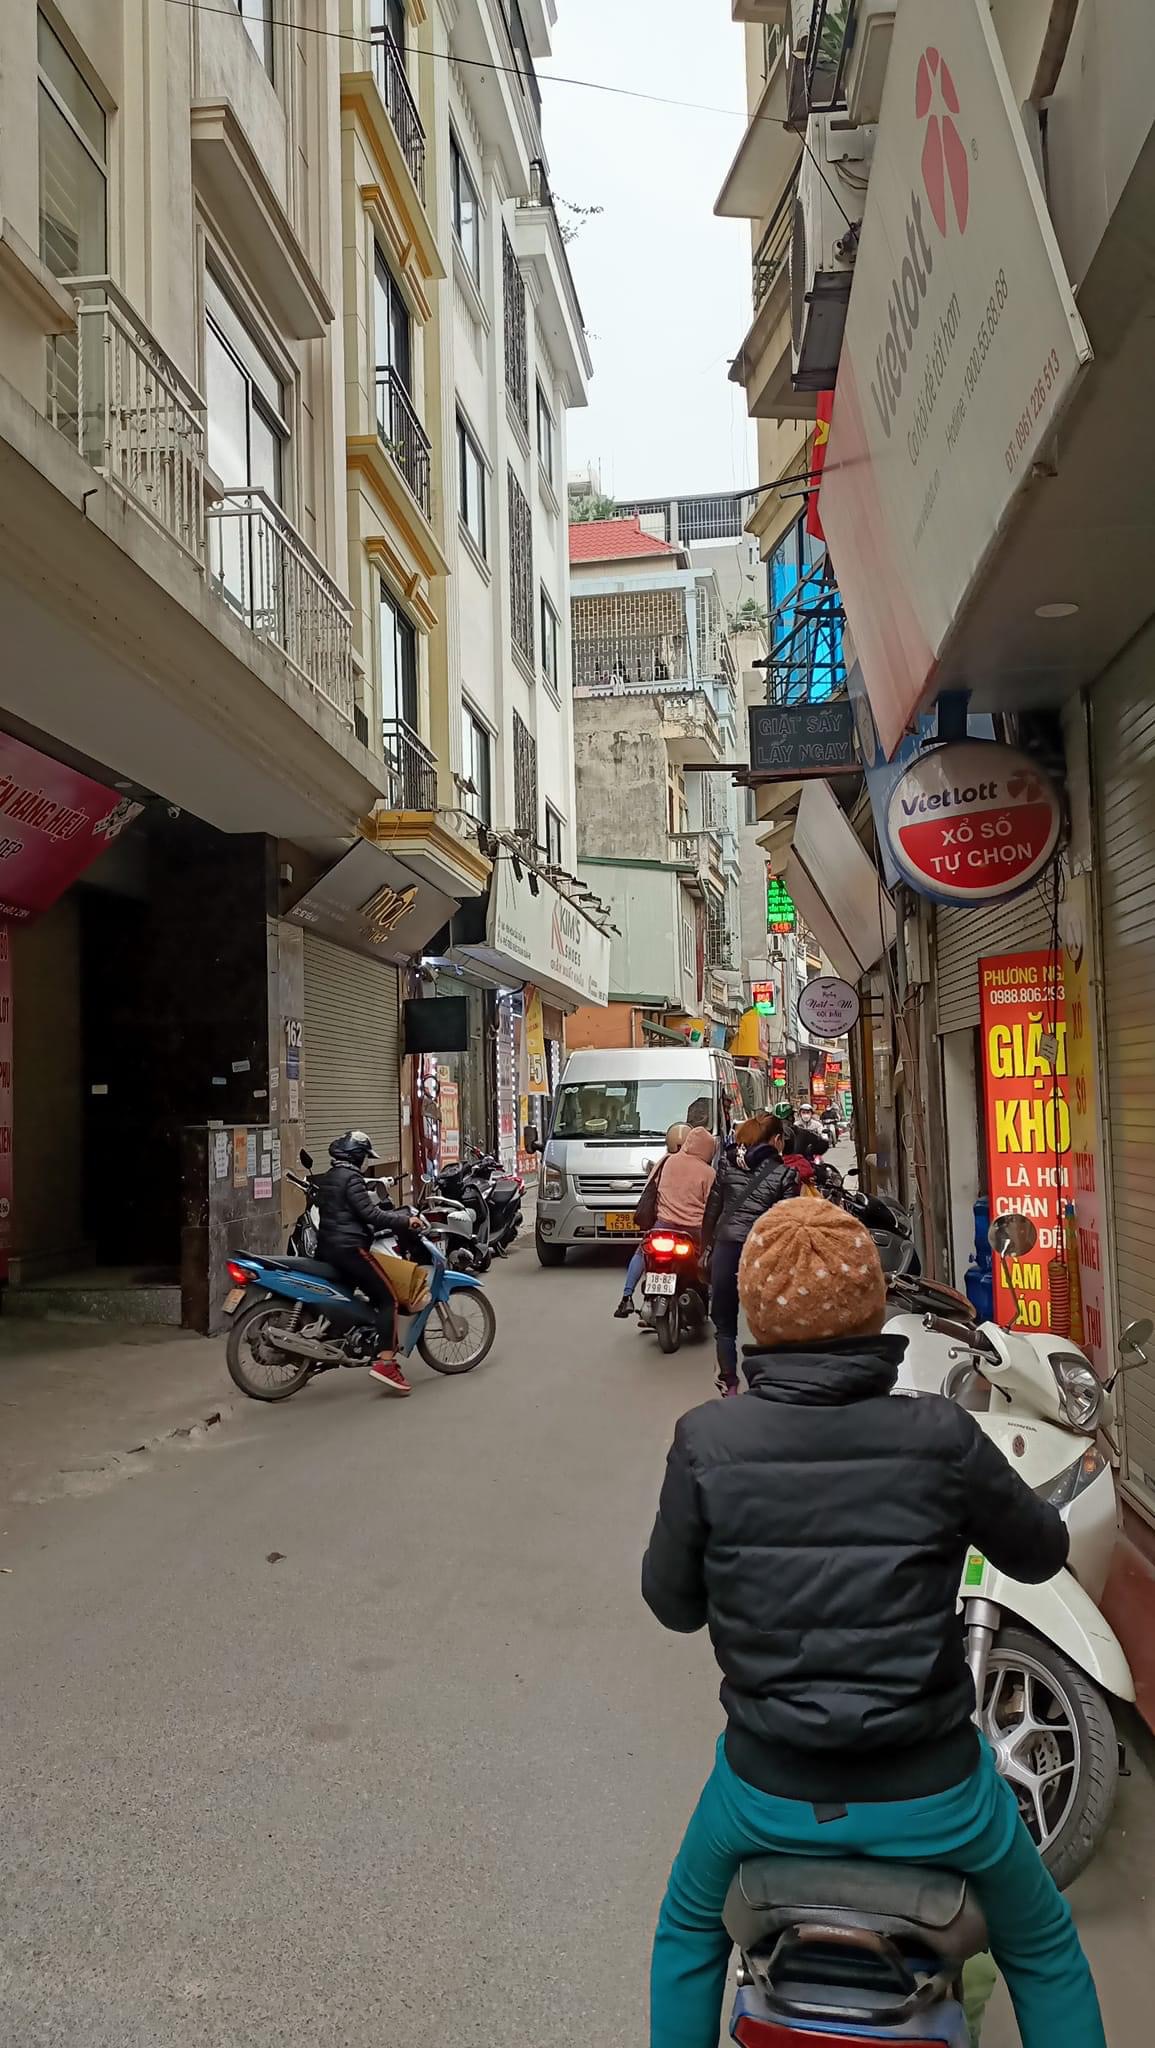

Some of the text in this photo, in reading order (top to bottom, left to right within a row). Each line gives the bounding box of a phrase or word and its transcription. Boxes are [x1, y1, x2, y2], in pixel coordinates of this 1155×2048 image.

[871, 188, 932, 438] Vietlott
[963, 267, 1009, 400] 1900.55.68.68
[1004, 348, 1060, 475] ĐT: 0961 226 513
[806, 708, 843, 733] SẤY
[799, 742, 849, 762] NGAY
[901, 781, 998, 816] Vietlott
[5, 789, 58, 828] HÀNG
[43, 807, 90, 843] HIỆU
[941, 812, 1012, 847] XỔ SỐ
[930, 842, 1033, 875] TỰ CHỌN
[984, 967, 1038, 987] PHƯƠNG
[806, 998, 828, 1009] Nail
[285, 1020, 303, 1048] 162
[988, 1011, 1068, 1089] GIẶT
[995, 1087, 1071, 1153] KHÔ
[1006, 1163, 1030, 1188] LÀ
[1000, 1257, 1041, 1291] LÀM
[1016, 1294, 1041, 1328] ÁO
